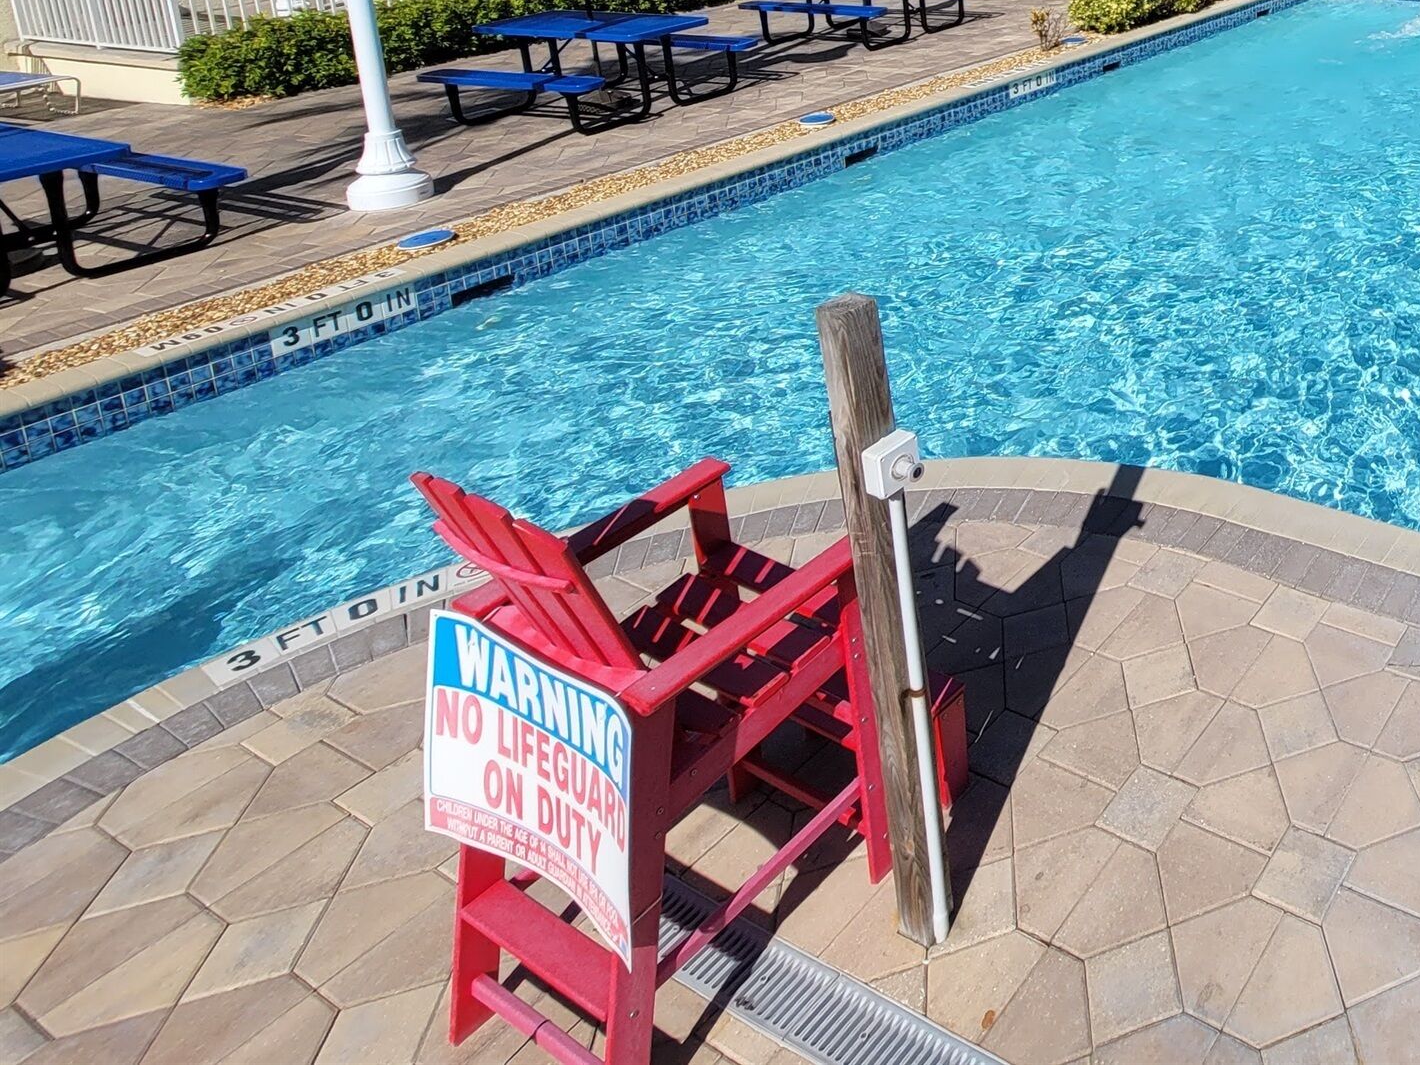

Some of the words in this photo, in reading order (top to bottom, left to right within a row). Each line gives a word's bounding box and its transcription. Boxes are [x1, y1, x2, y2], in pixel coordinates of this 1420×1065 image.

[1013, 83, 1019, 94] 3
[1022, 79, 1032, 92] FT
[283, 326, 300, 347] 3
[312, 311, 342, 337] FT
[386, 288, 411, 312] IN
[226, 649, 261, 672] 3
[276, 615, 327, 651] FT
[399, 574, 440, 604] IN
[455, 624, 624, 789] WARNING
[436, 688, 483, 745] NO
[497, 707, 626, 854] LIFEGUARD
[436, 799, 473, 823] CHILDREN
[474, 810, 498, 831] UNDER
[500, 820, 513, 838] THE
[514, 827, 529, 845] AGE
[529, 834, 539, 850] OF
[446, 816, 478, 840] WITHOUT
[479, 828, 486, 844] A
[486, 831, 514, 855] PARENT
[515, 843, 526, 860] OR
[527, 848, 547, 871] ADULT
[483, 759, 523, 821] ON
[537, 784, 602, 875] DUTY
